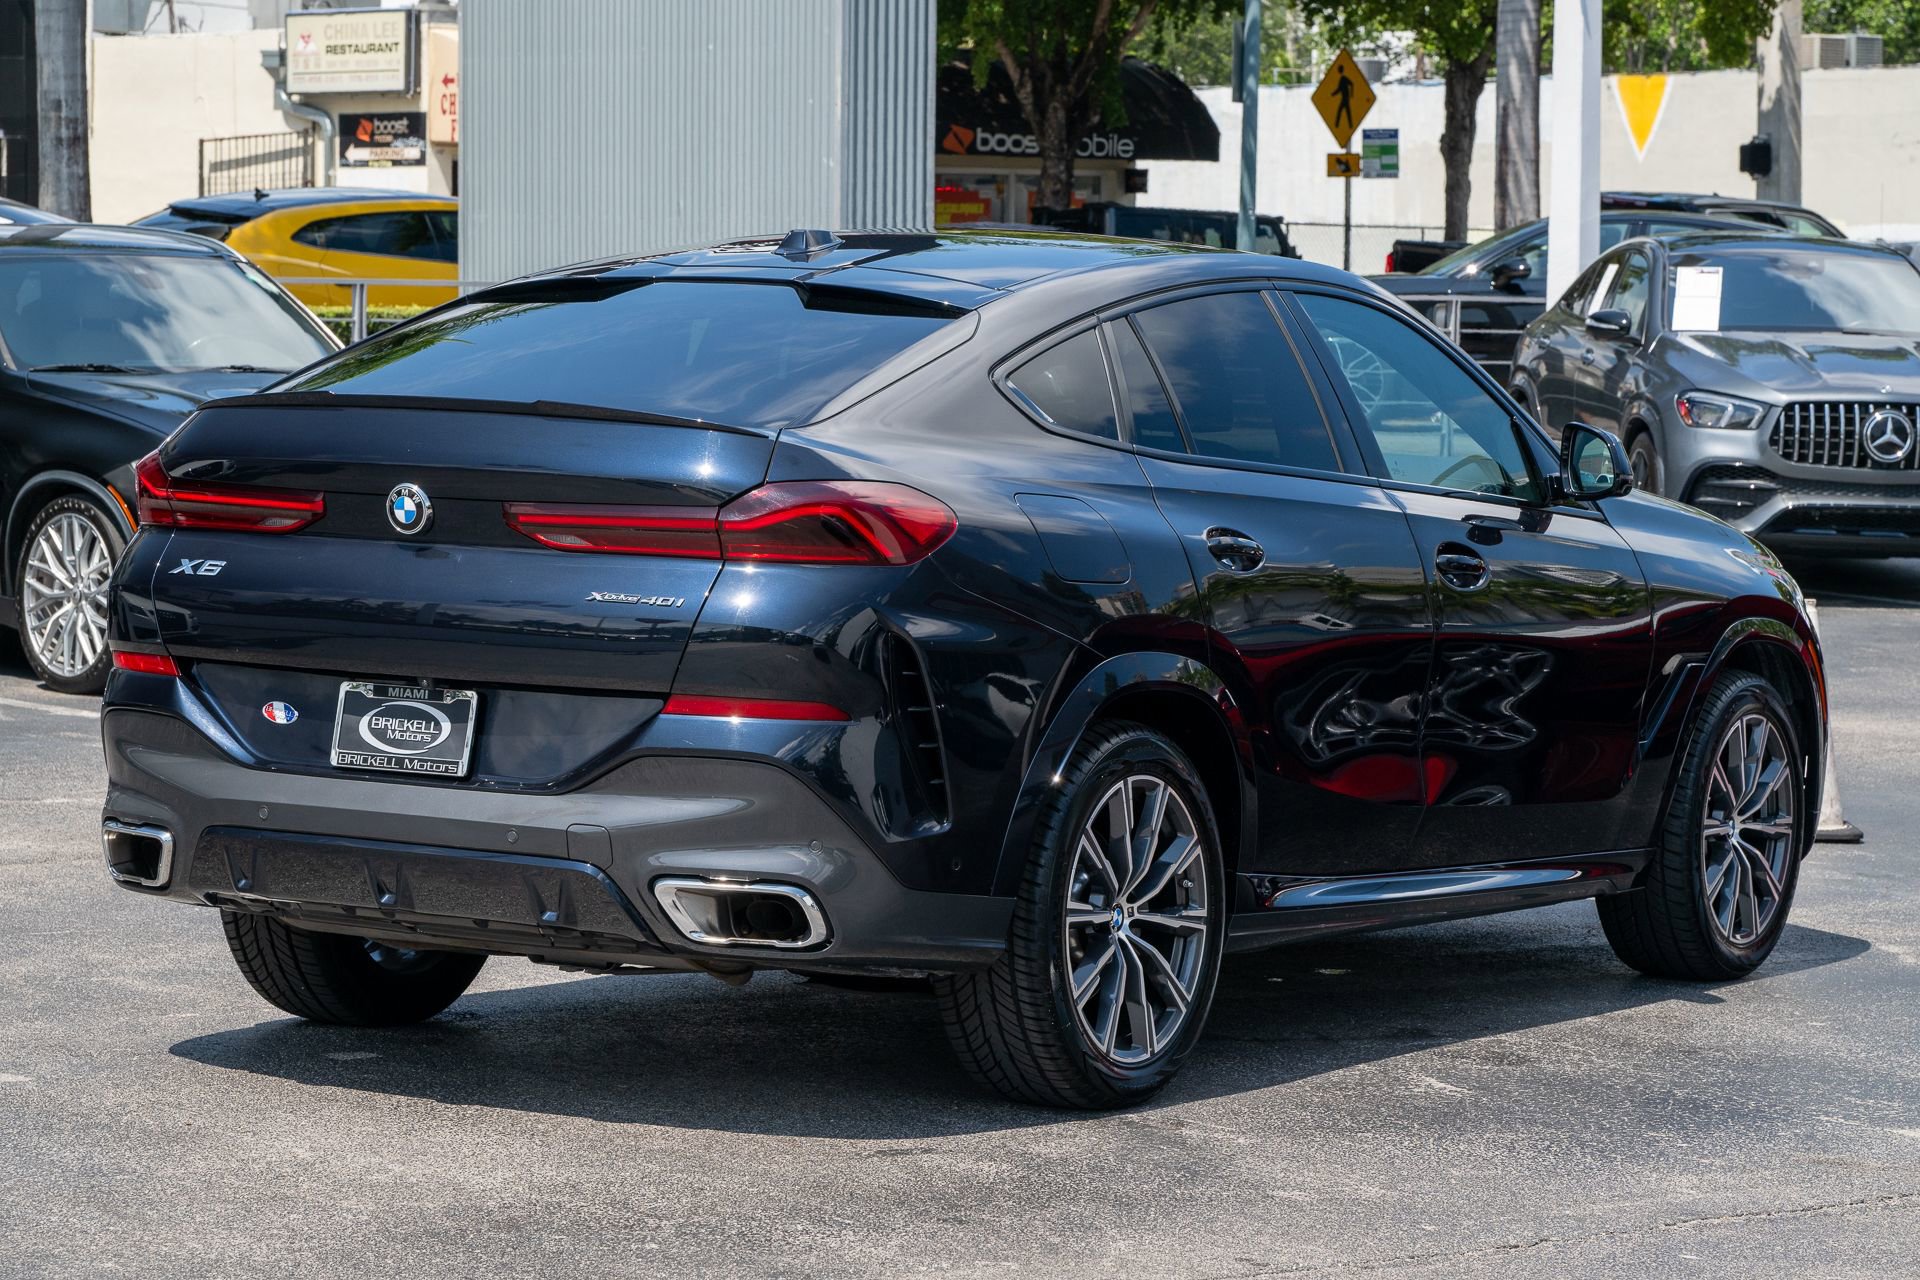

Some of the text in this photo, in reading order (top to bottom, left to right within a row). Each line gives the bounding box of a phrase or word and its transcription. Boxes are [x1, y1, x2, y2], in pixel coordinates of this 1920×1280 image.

[324, 21, 400, 41] CHINA LEE
[325, 42, 400, 55] RESTAURANT
[440, 93, 457, 116] CH
[374, 117, 409, 134] boost
[976, 127, 1135, 158] boos obile
[391, 488, 421, 504] BMW
[168, 558, 227, 576] X6
[387, 687, 429, 700] MIAMI
[371, 716, 439, 733] BRICKELL
[387, 730, 431, 742] Motors
[338, 754, 458, 773] BRICKELL Motors
